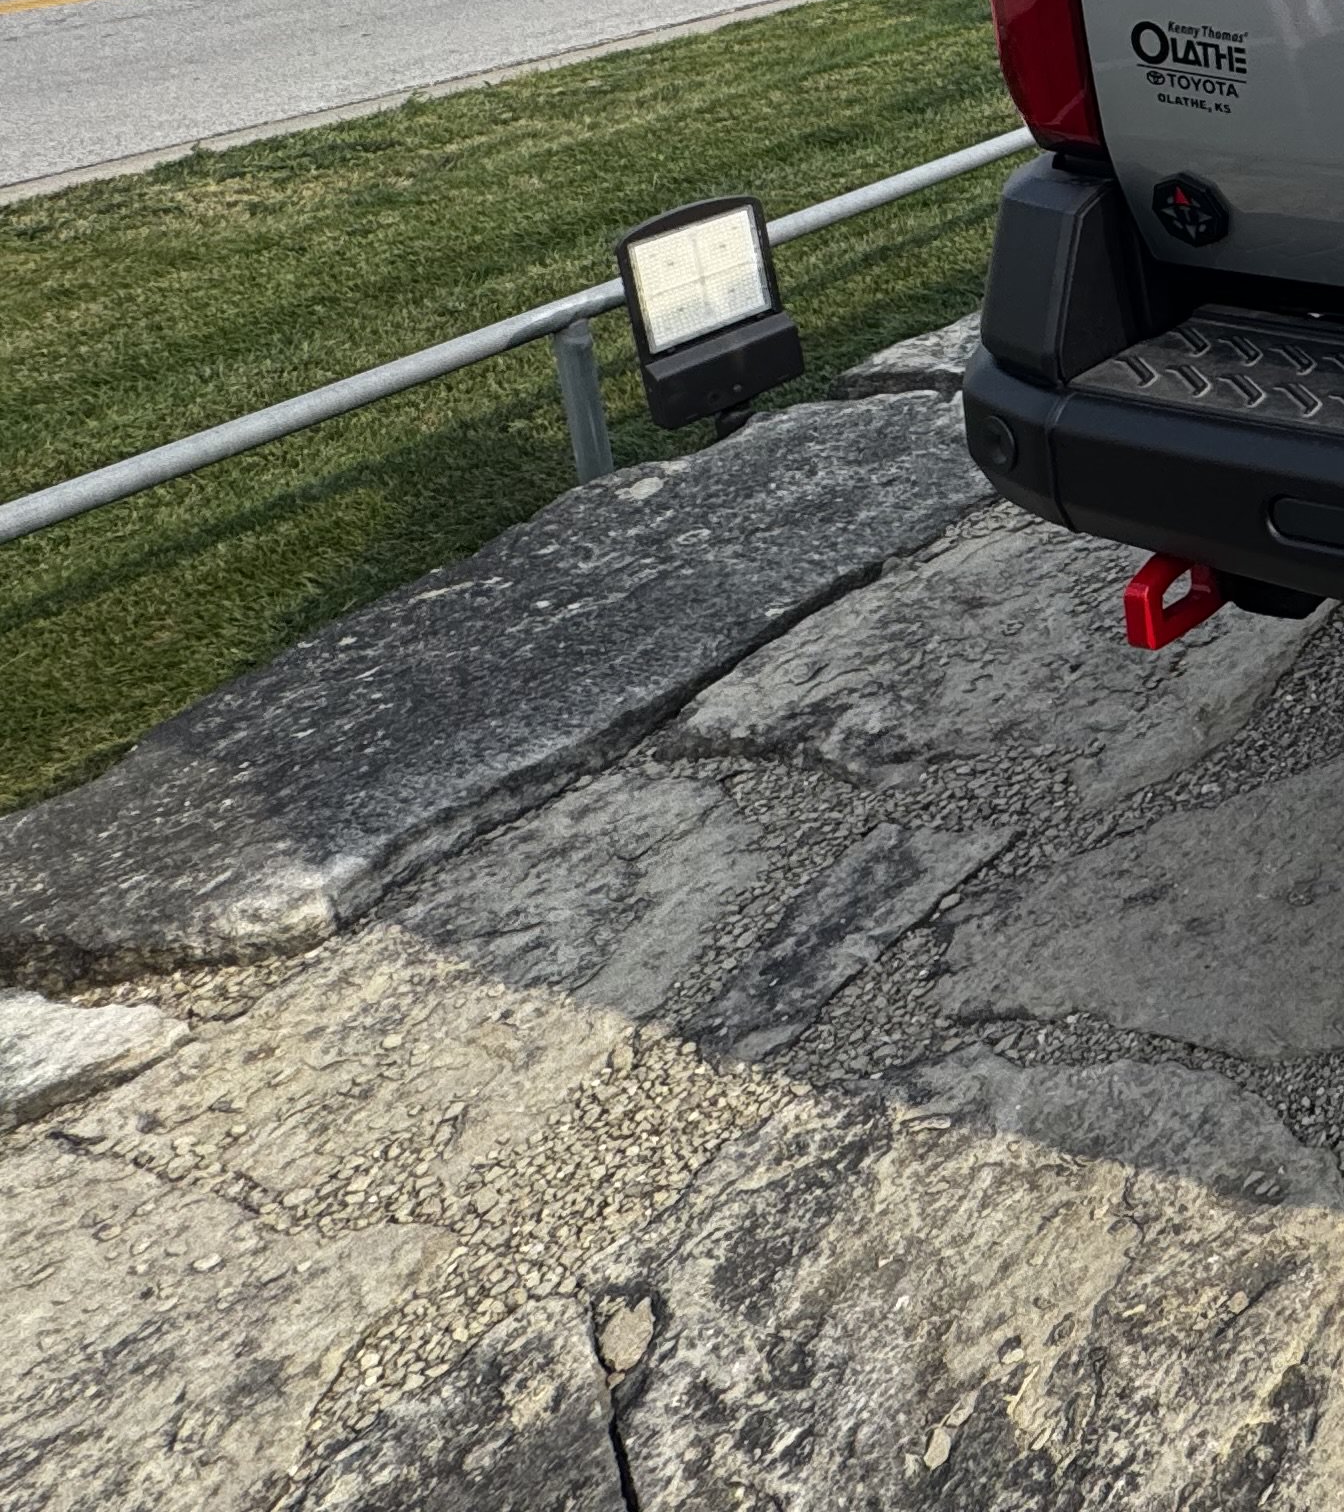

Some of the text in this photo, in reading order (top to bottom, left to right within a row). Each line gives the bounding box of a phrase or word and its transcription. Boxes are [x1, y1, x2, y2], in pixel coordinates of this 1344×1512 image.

[1168, 21, 1199, 38] Kenny
[1131, 21, 1247, 74] OLATHE
[1167, 73, 1239, 98] TOYOTA
[1158, 93, 1231, 113] OLATHE, KS
